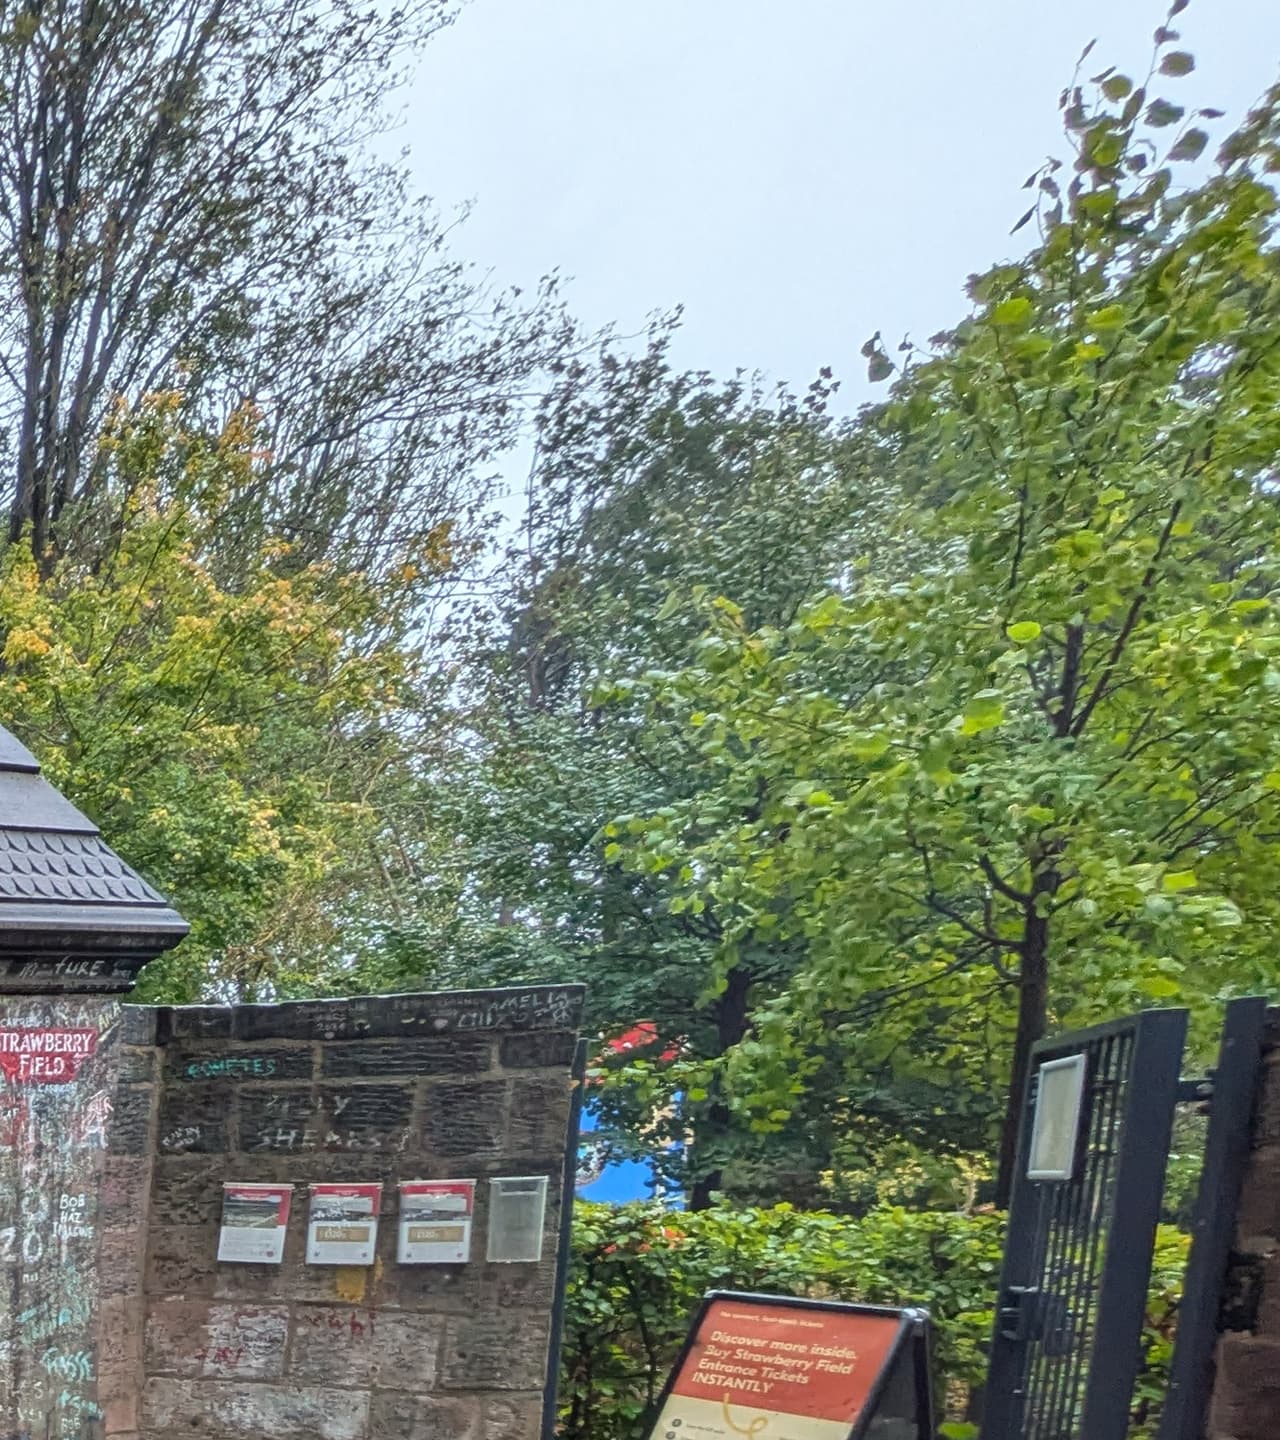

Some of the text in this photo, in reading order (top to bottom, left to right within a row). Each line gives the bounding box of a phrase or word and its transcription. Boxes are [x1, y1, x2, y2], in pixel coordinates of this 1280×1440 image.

[20, 1055, 65, 1075] FIELD
[711, 1331, 857, 1359] Discover more inside.
[699, 1359, 810, 1385] Entrance Tickets
[704, 1345, 854, 1376] Buy Strawberry Field
[692, 1372, 774, 1394] INSTANTLY
